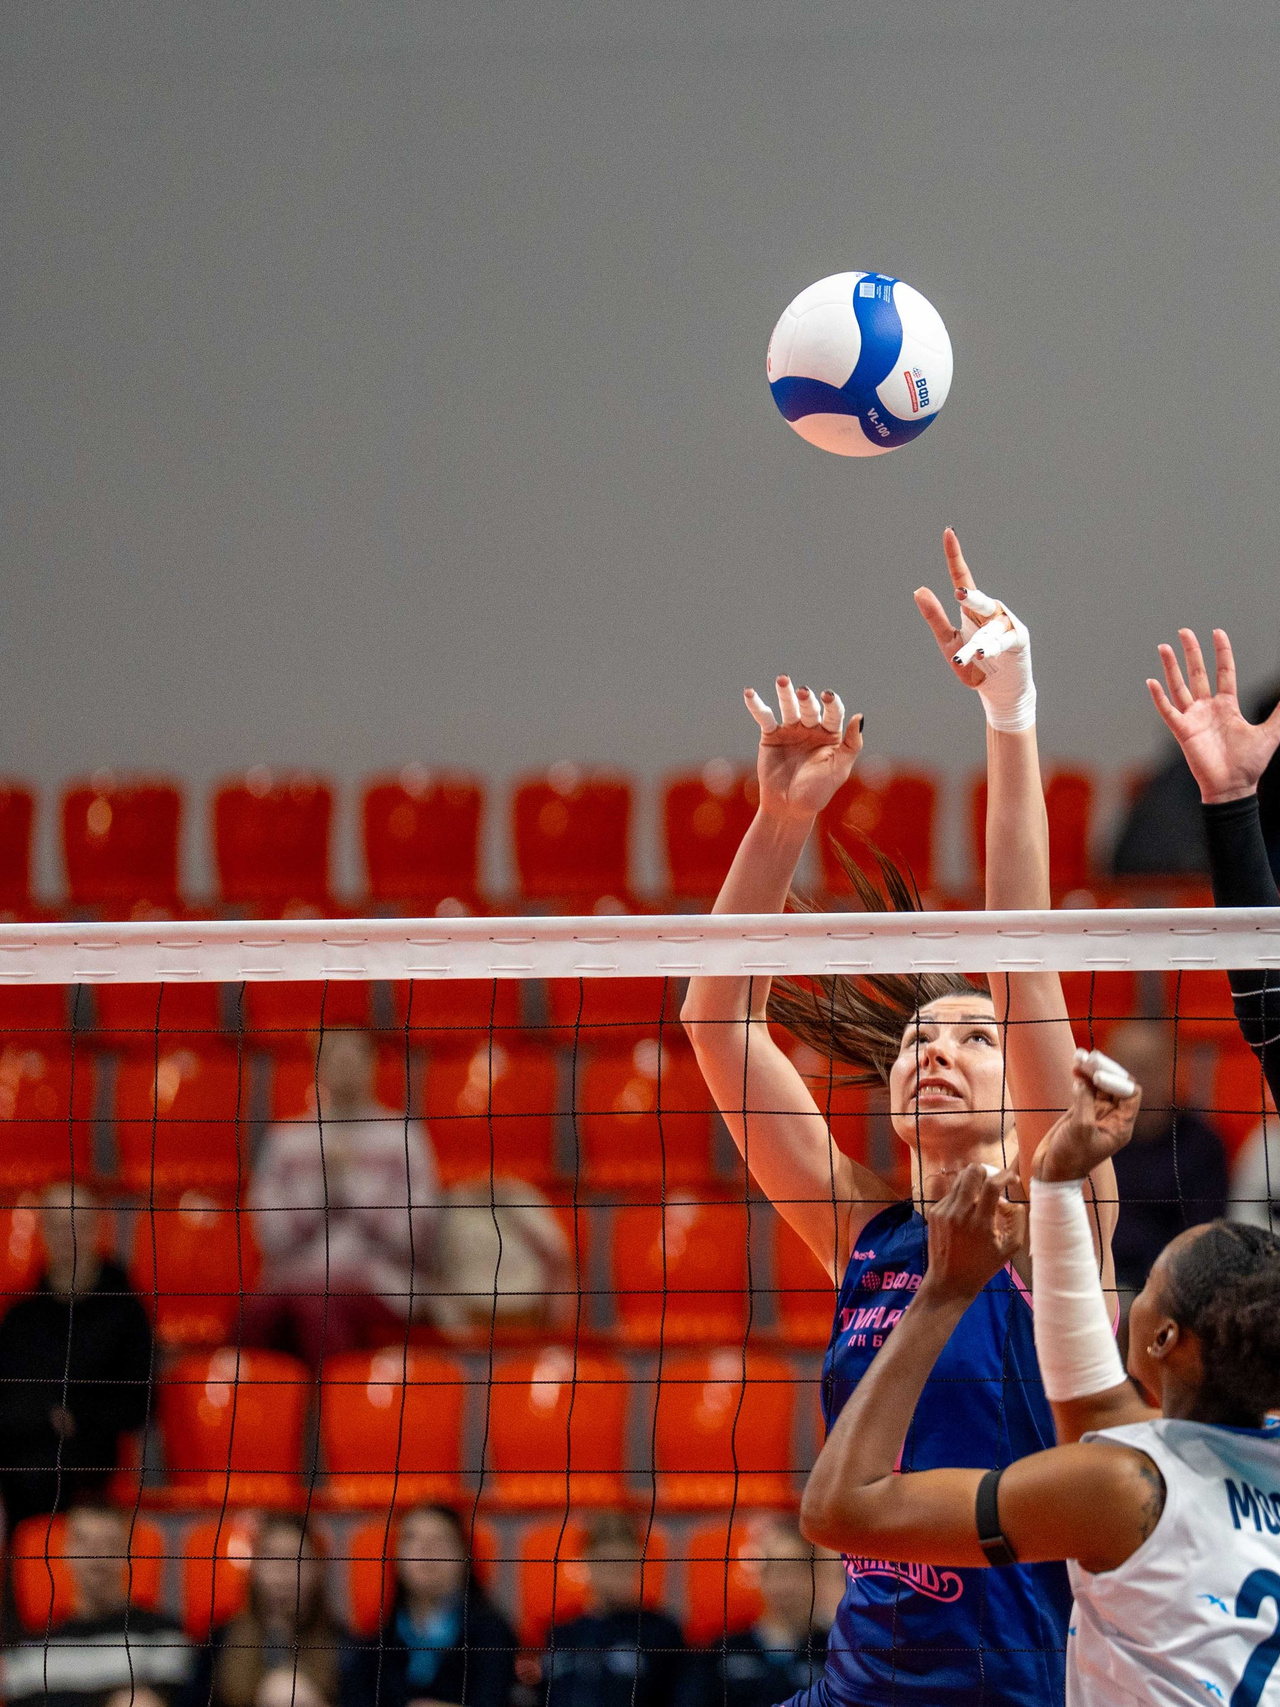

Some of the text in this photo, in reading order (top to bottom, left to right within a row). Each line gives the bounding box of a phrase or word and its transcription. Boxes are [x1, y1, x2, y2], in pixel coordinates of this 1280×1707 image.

[915, 377, 930, 408] ВФВ
[867, 407, 890, 438] VL-100
[881, 1271, 923, 1291] ВФВ
